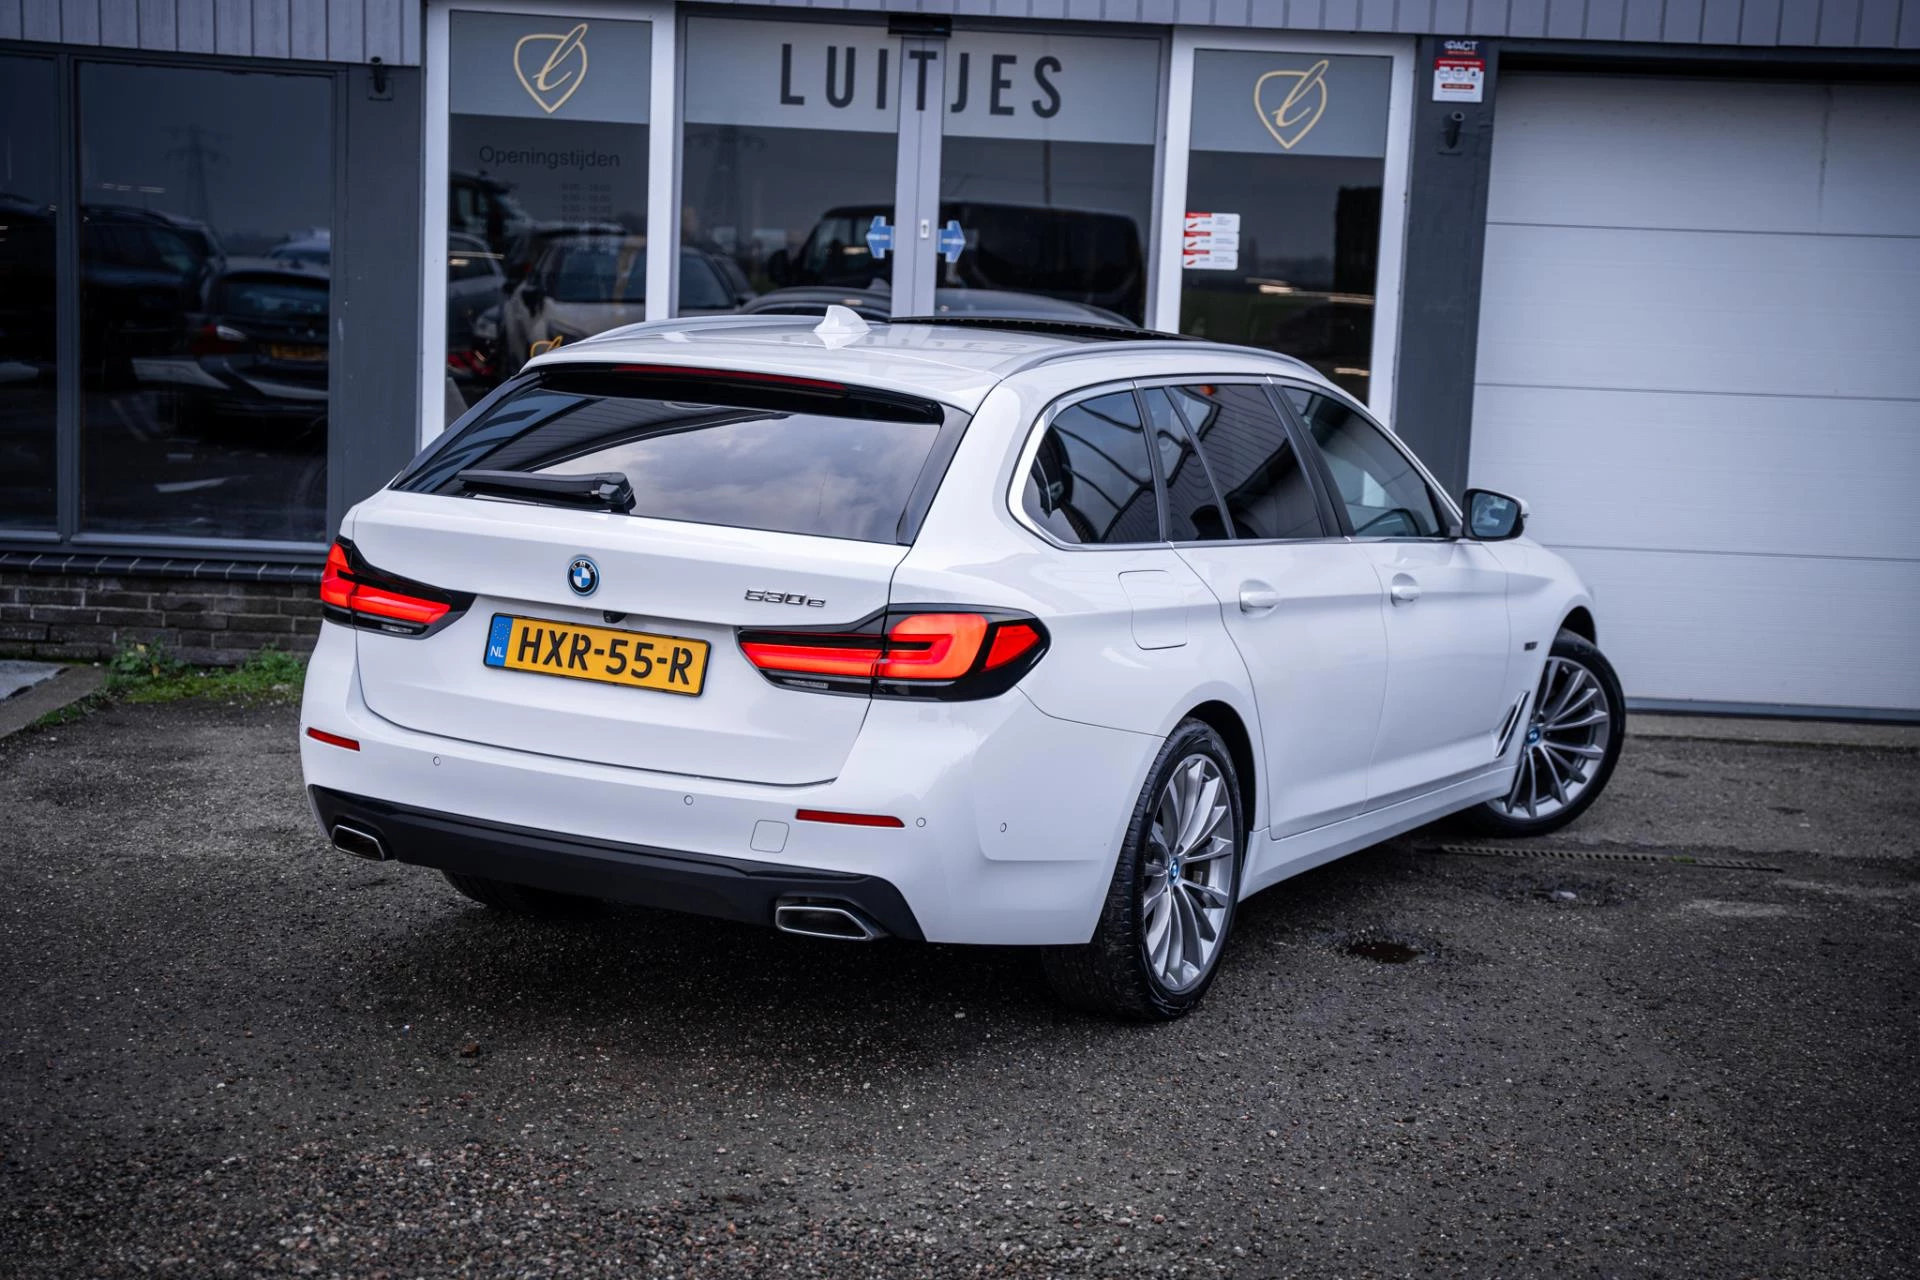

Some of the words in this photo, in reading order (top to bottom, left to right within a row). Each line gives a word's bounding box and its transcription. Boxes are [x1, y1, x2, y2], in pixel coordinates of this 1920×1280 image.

[780, 43, 1063, 119] LUITJES
[479, 145, 621, 170] Openingstijden
[744, 589, 826, 608] 530e
[490, 645, 504, 659] NL
[517, 626, 694, 686] HXR-55-R
